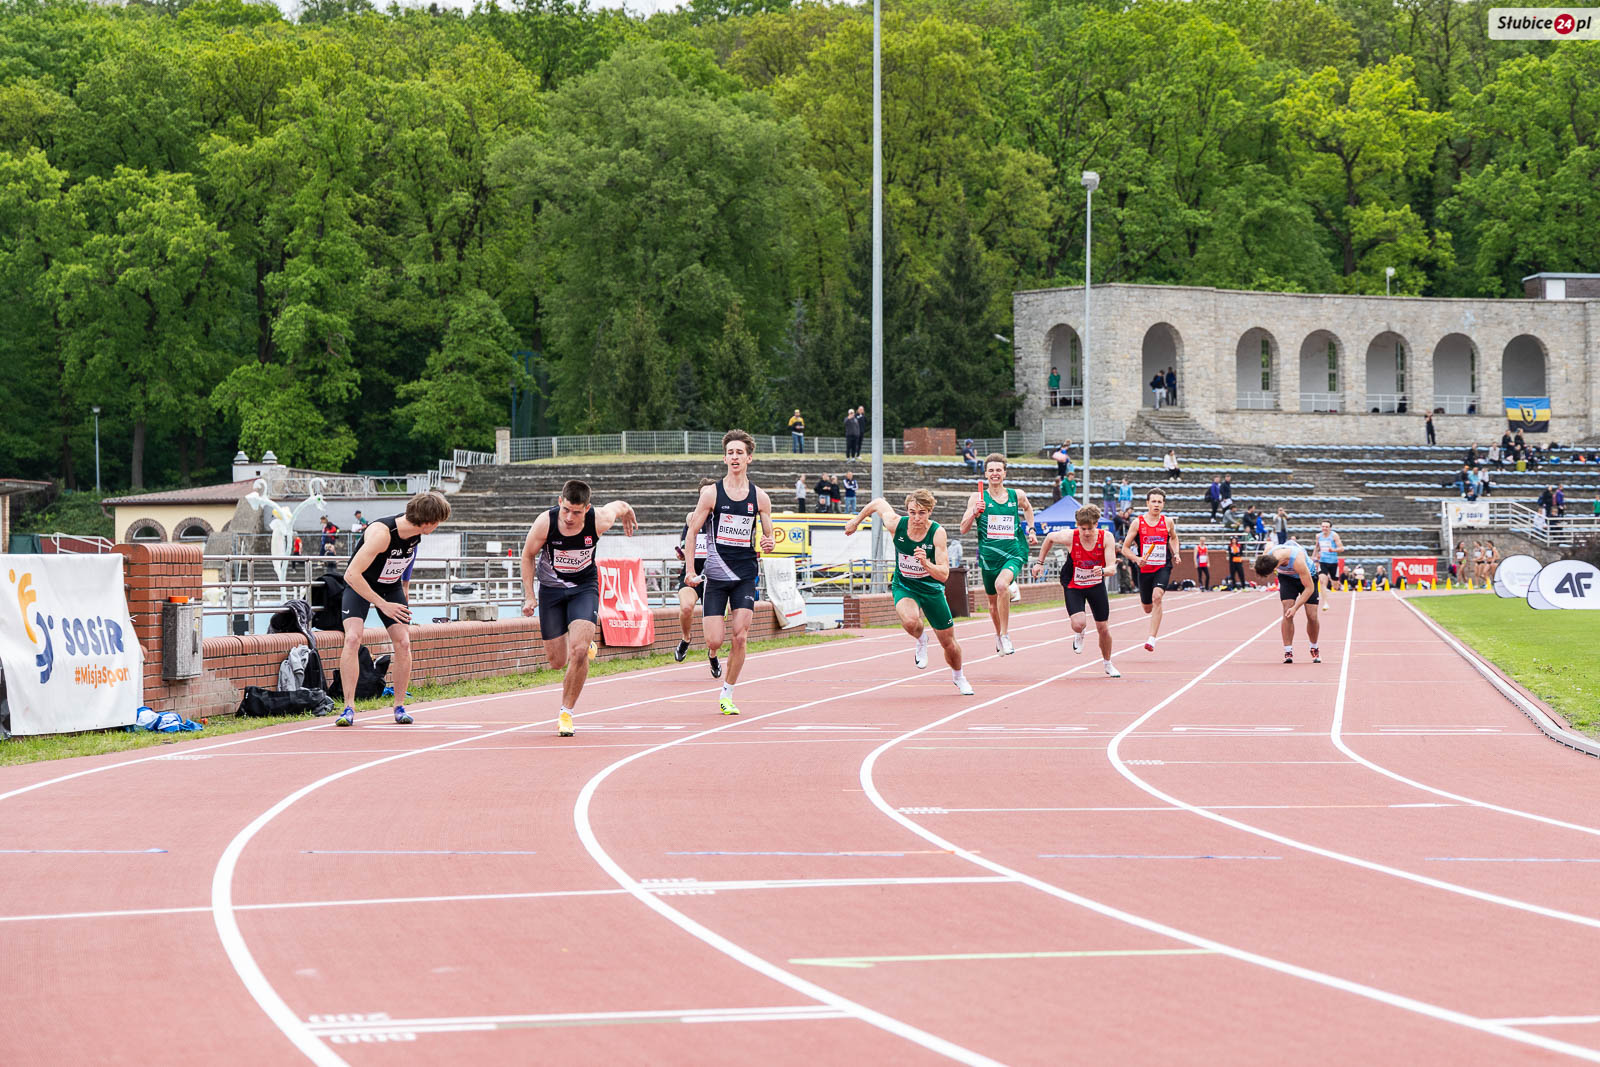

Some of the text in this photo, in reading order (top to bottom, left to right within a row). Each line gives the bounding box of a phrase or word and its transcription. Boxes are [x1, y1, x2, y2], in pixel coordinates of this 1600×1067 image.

[719, 526, 750, 536] BIERNACKI
[1408, 564, 1434, 575] ORLEN
[1554, 572, 1593, 598] 4F
[75, 664, 131, 689] #MisjaSpor
